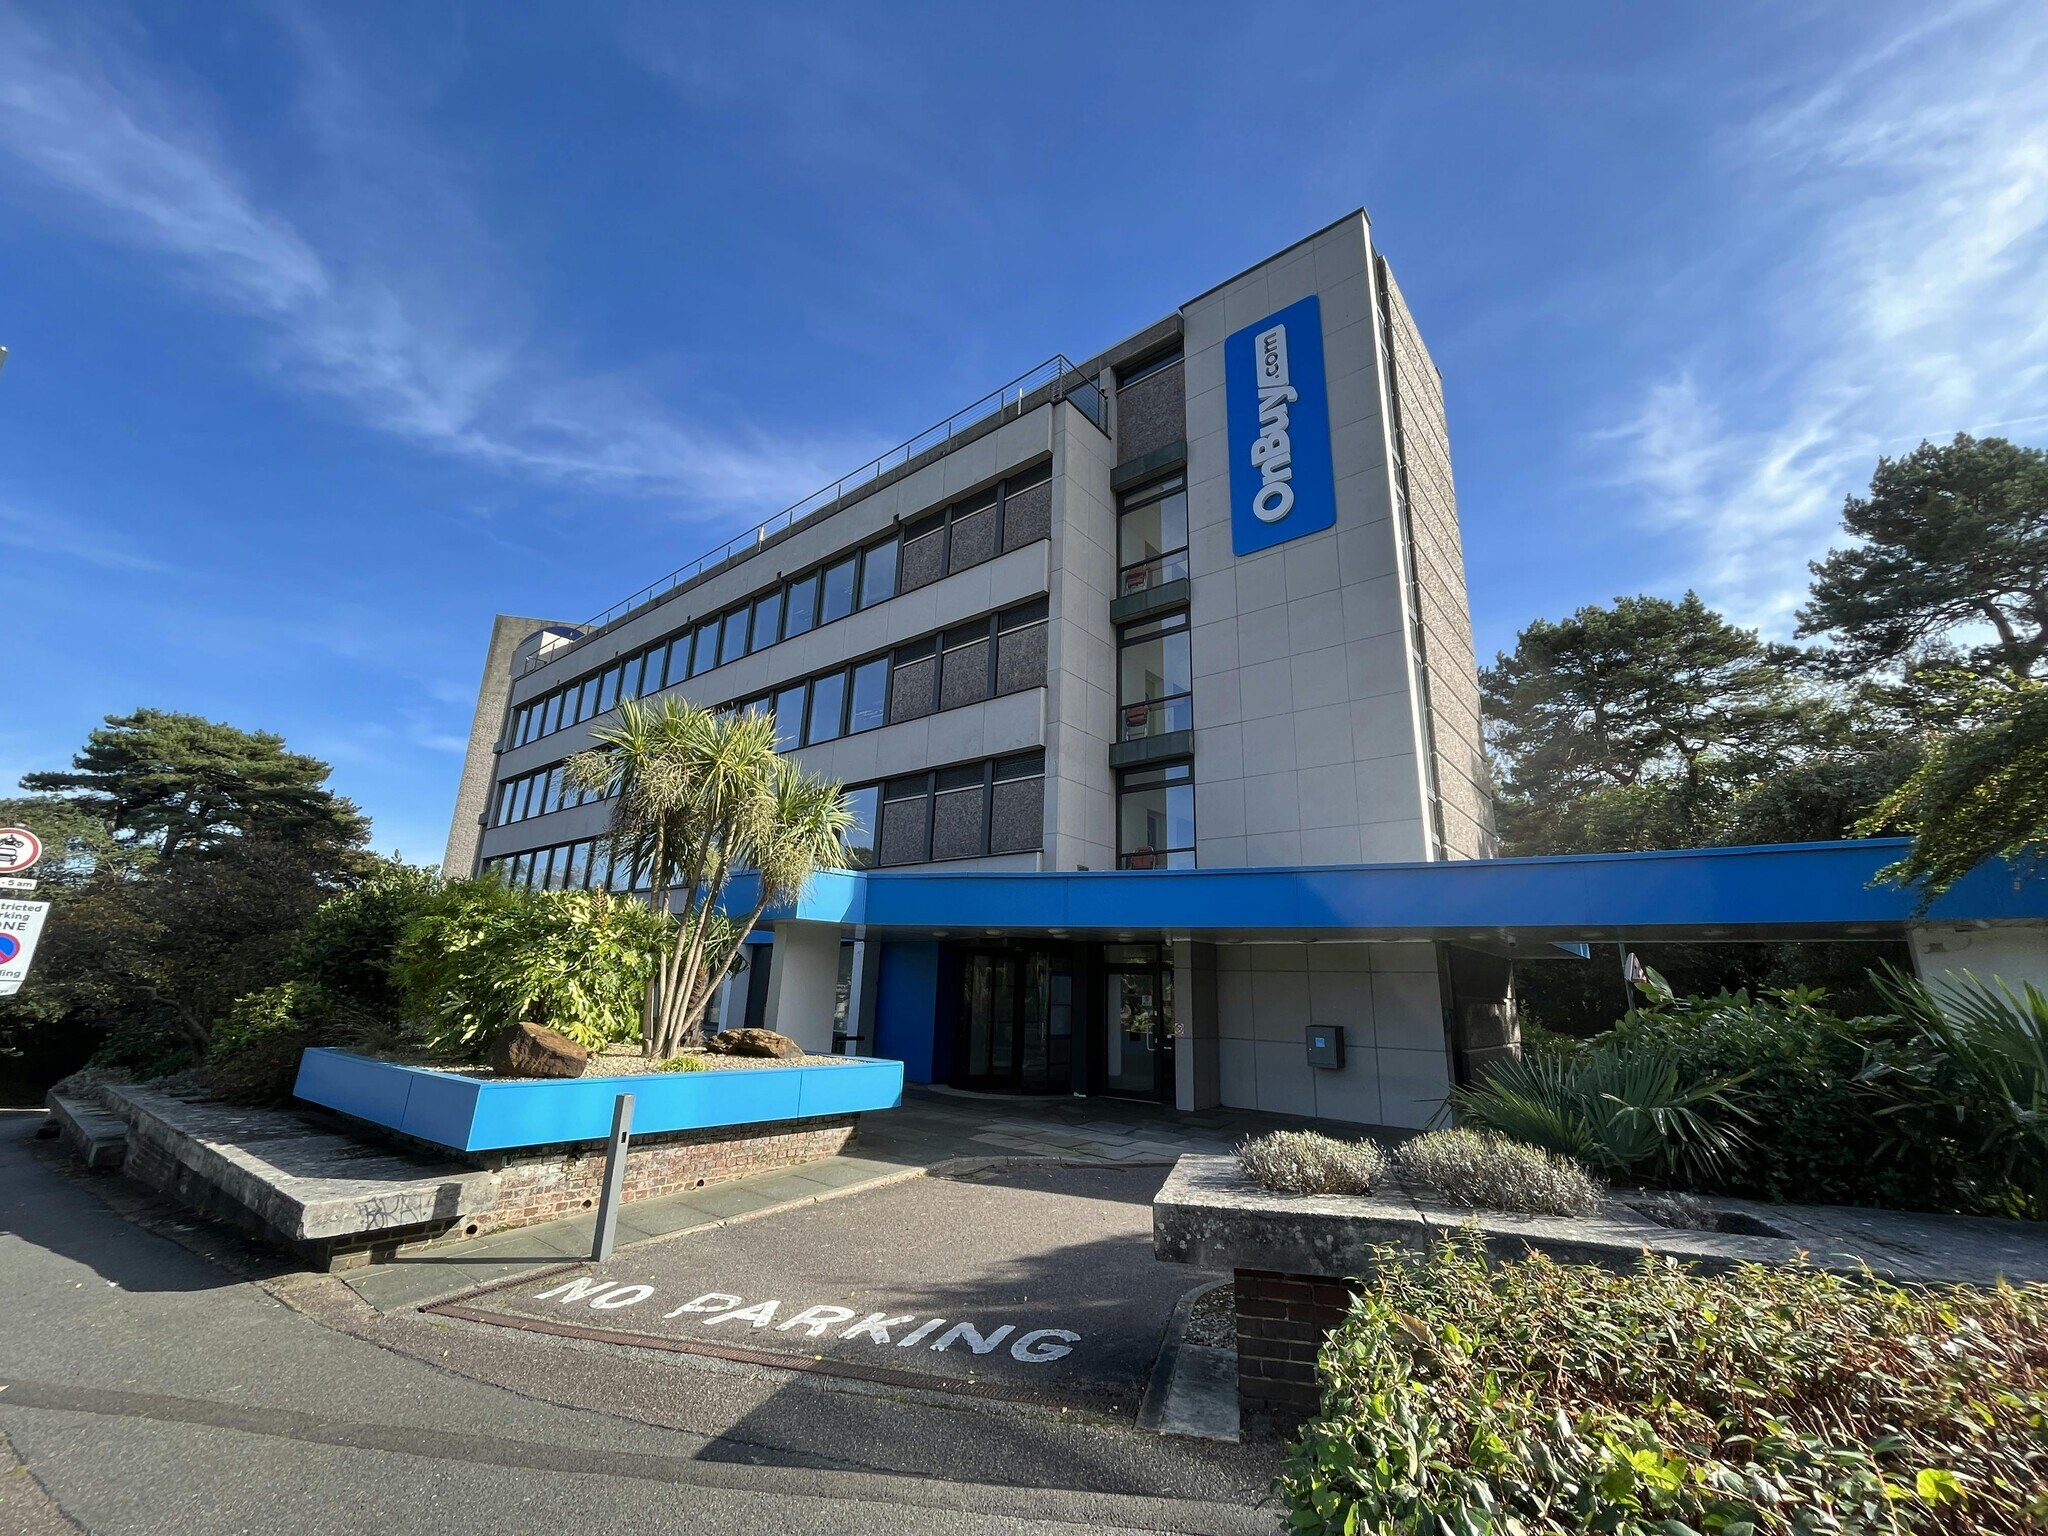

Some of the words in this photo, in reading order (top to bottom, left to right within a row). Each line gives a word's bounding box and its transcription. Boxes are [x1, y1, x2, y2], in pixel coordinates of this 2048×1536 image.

[0, 921, 28, 931] NE
[533, 1277, 655, 1310] NO
[662, 1292, 1082, 1363] PARKING
